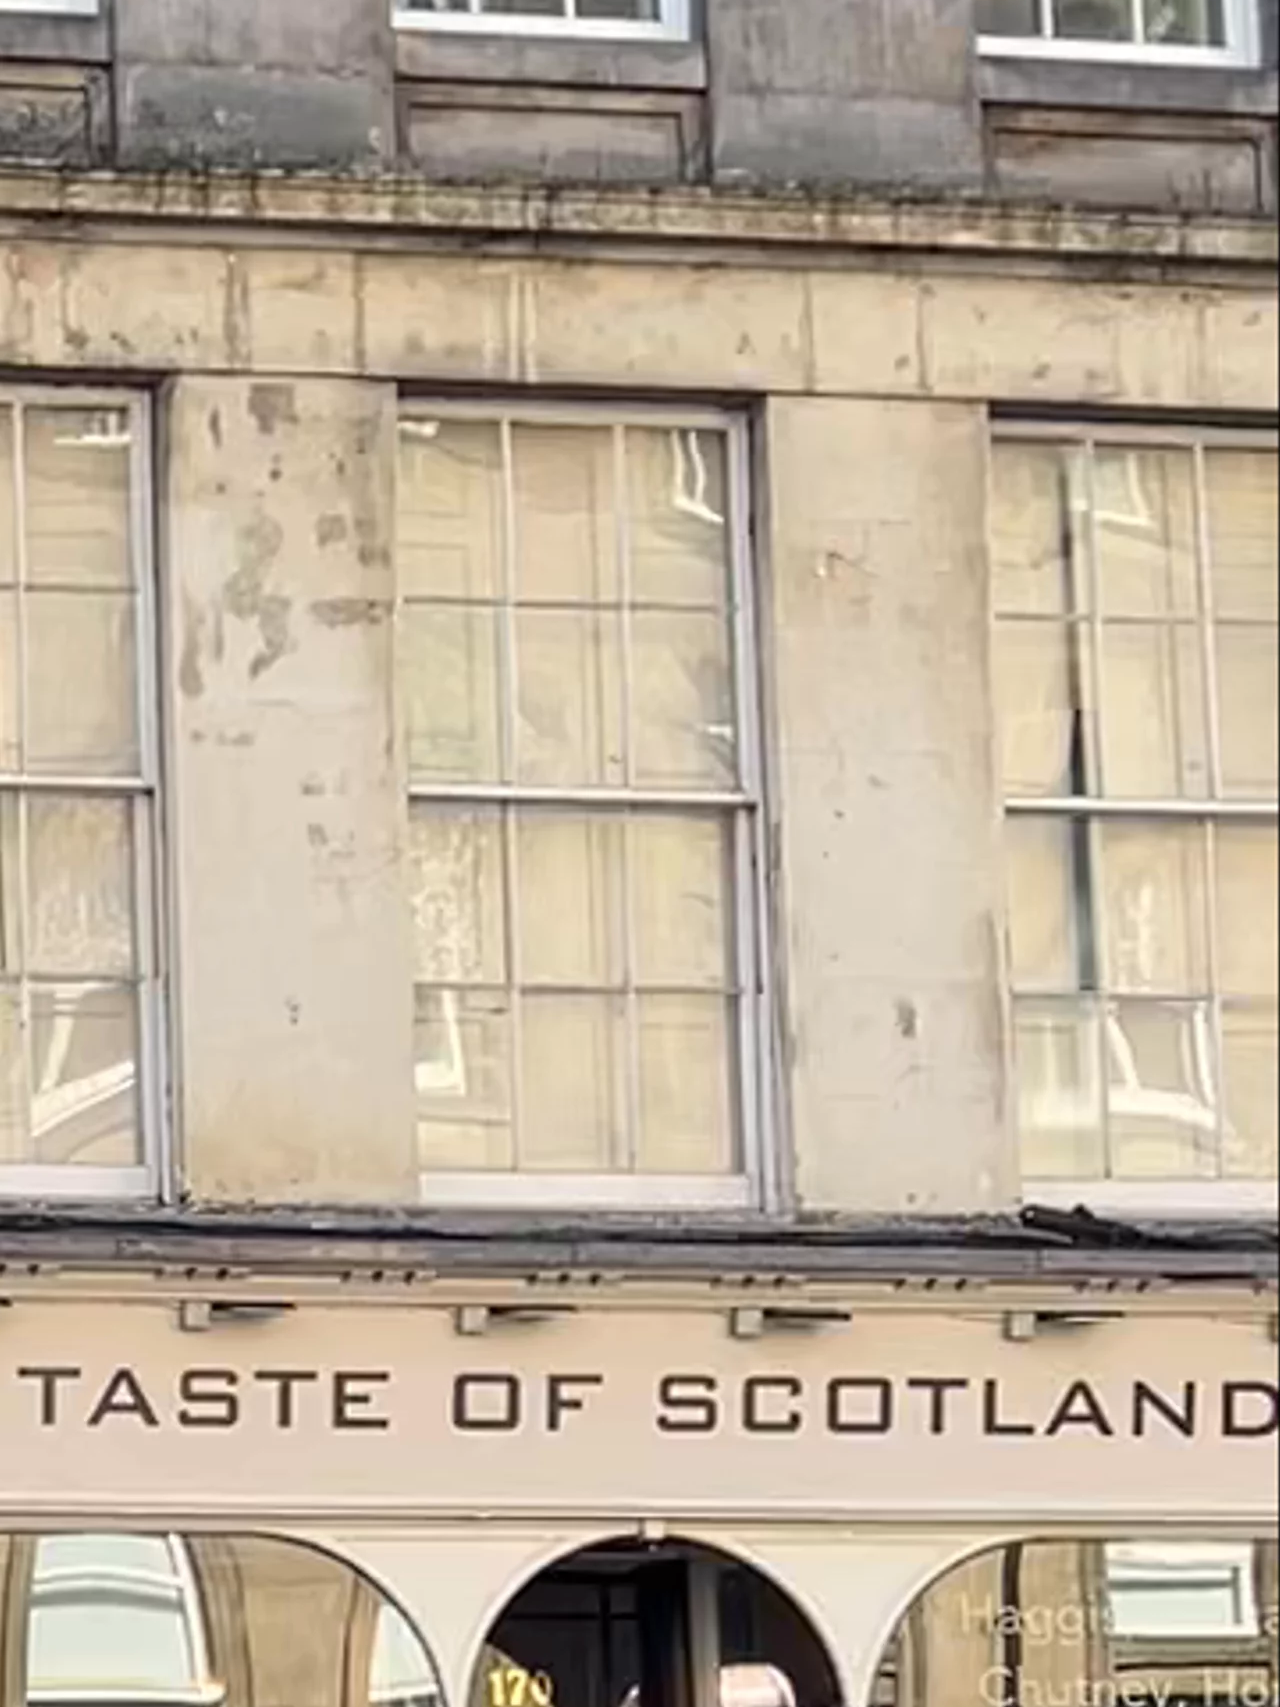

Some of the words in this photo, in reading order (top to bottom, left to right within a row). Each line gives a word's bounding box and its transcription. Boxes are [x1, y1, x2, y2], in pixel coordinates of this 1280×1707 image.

[17, 1367, 389, 1429] TASTE
[452, 1373, 604, 1431] OF
[656, 1376, 1278, 1437] SCOTLAND
[488, 1669, 552, 1707] 170
